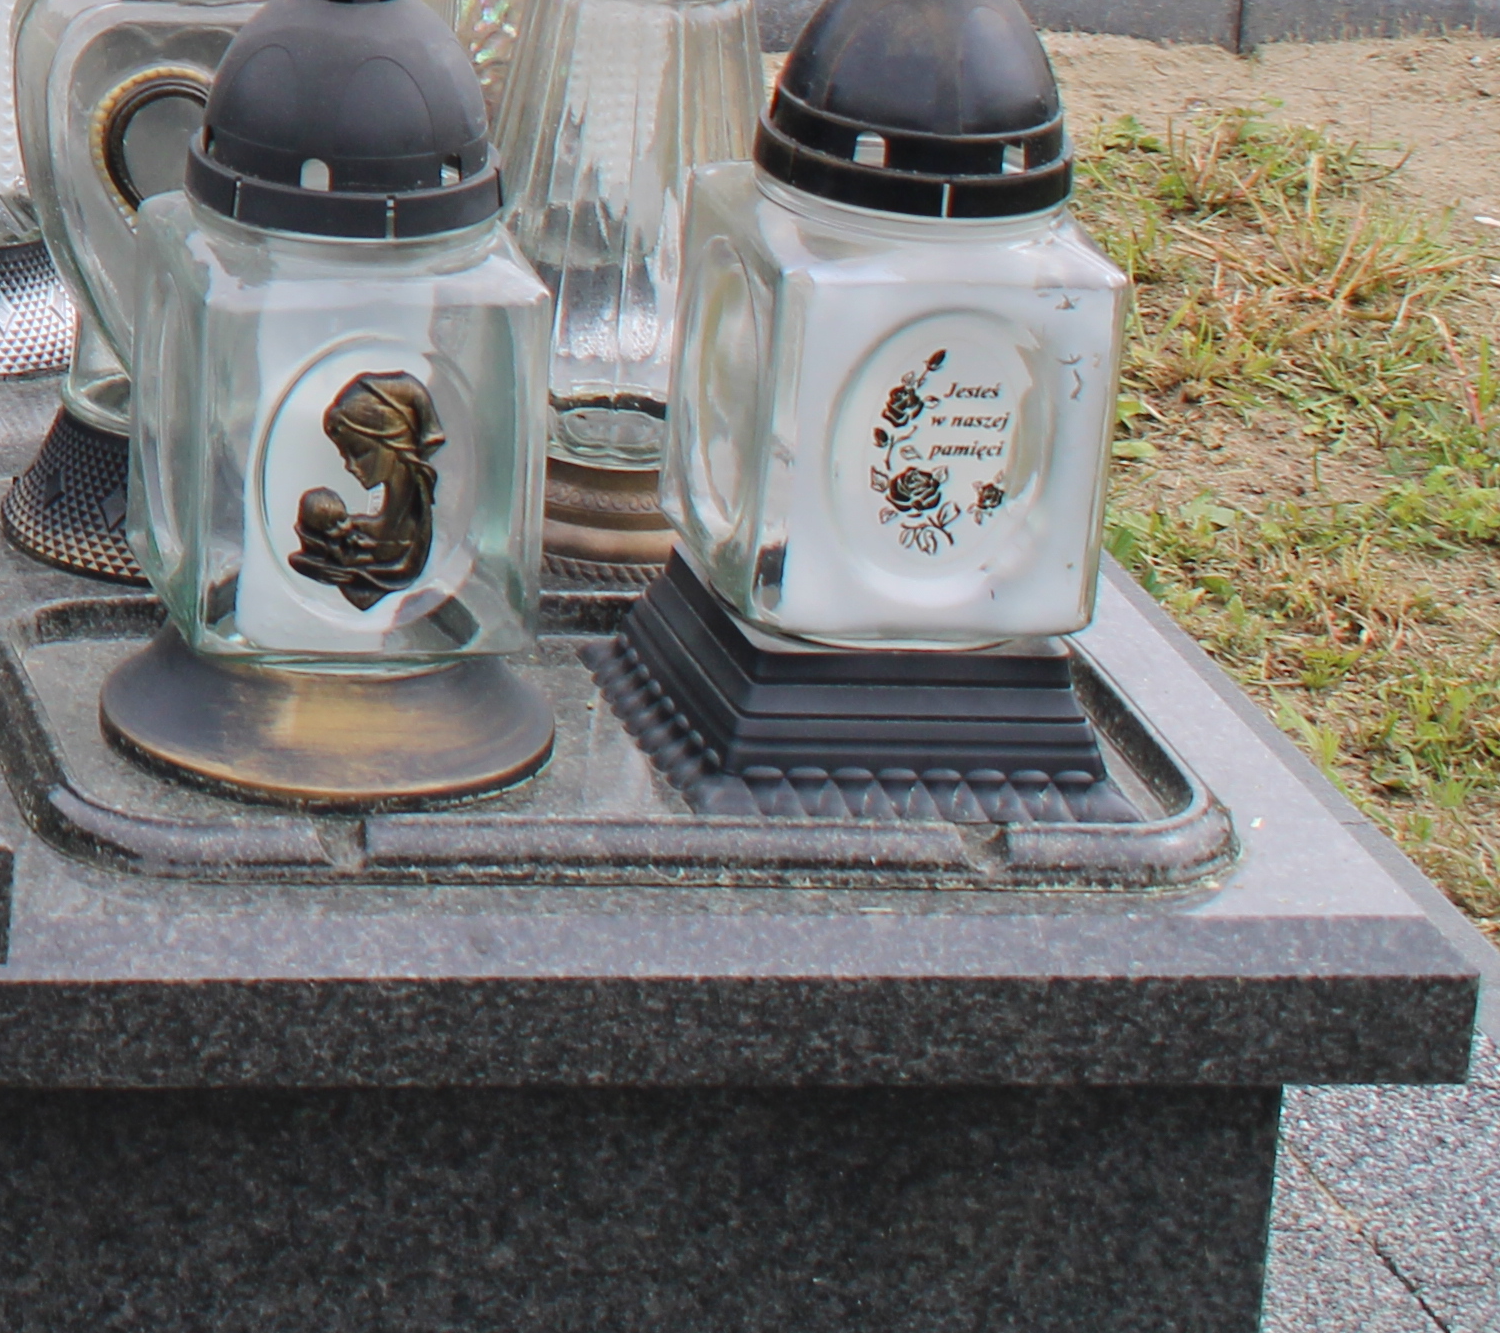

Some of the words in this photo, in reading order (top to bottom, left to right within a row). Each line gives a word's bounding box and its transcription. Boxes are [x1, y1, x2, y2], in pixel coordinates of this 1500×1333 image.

[943, 382, 1001, 399] Jesteś
[931, 416, 946, 426] w
[950, 412, 1011, 432] naszej
[928, 441, 1005, 461] pamięci
